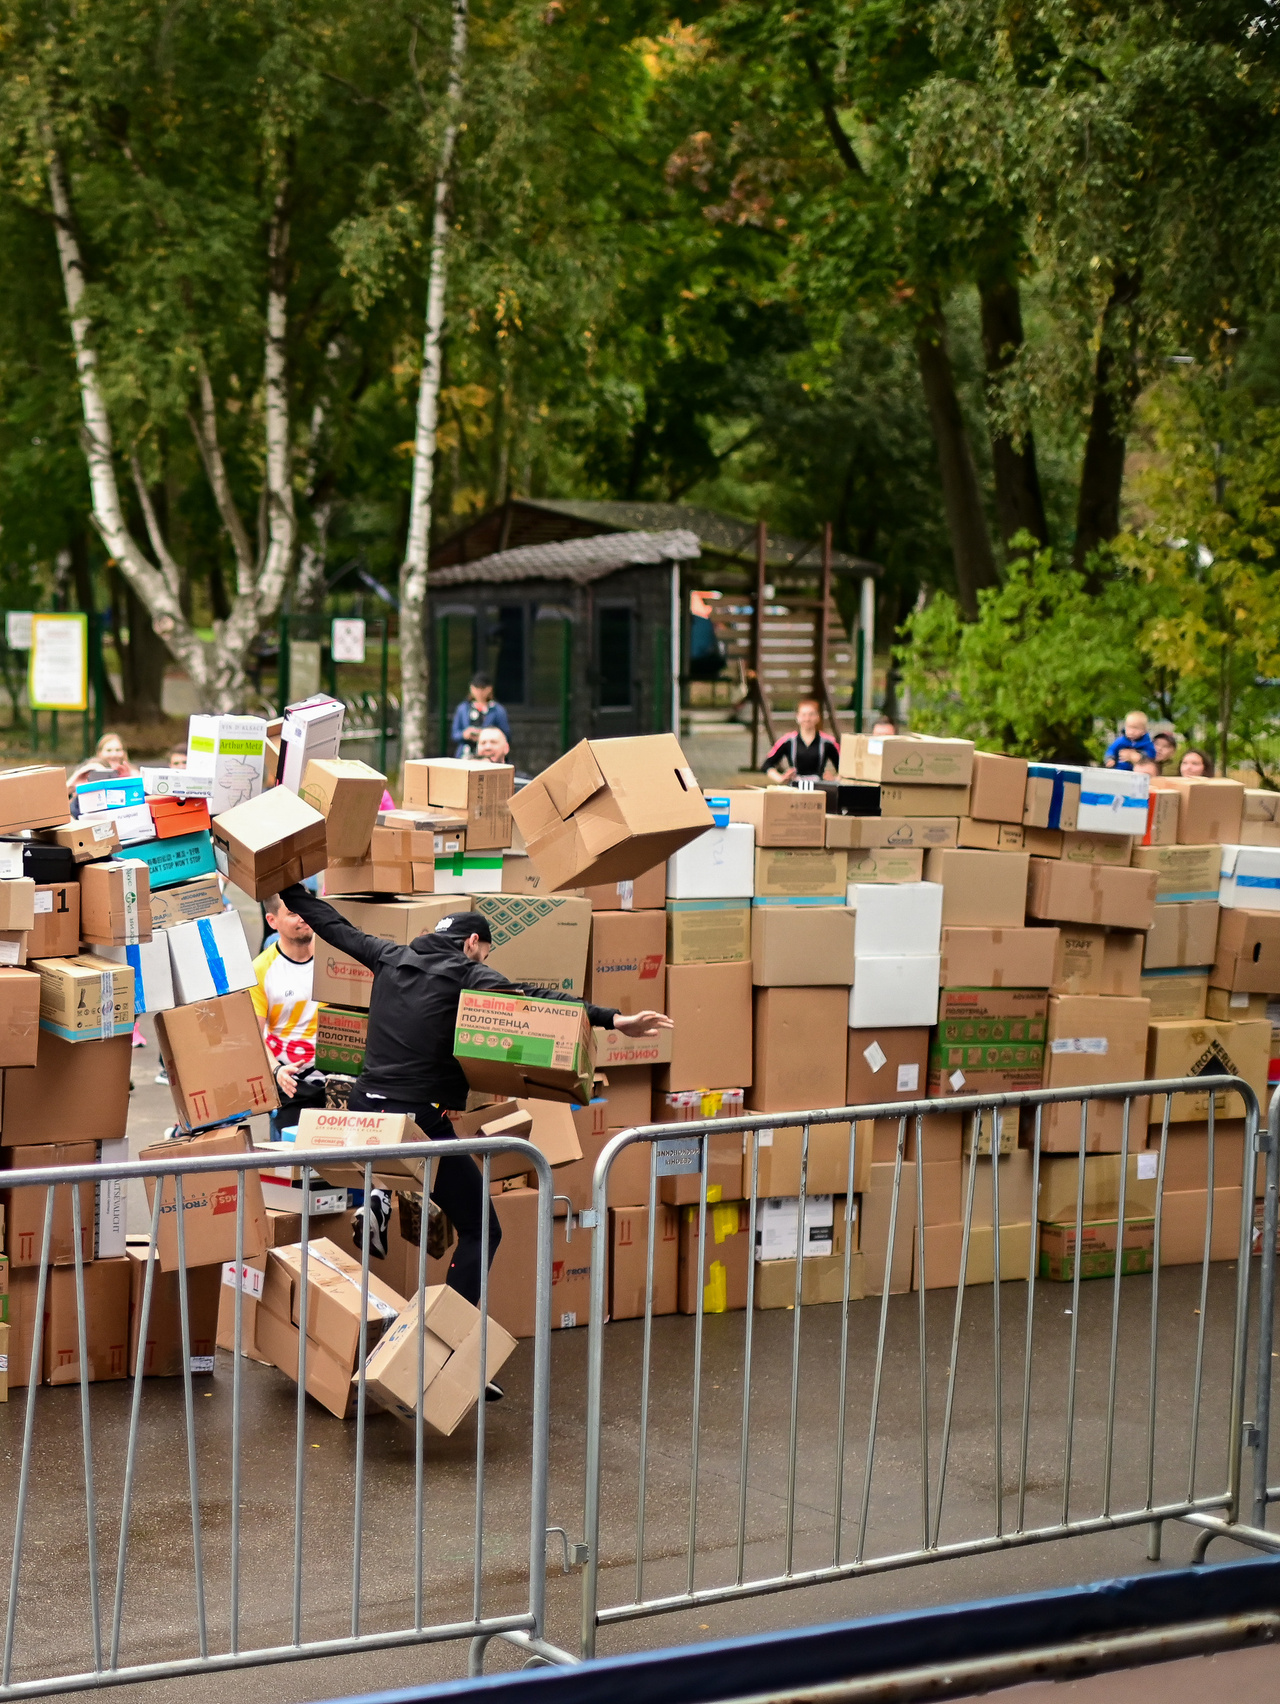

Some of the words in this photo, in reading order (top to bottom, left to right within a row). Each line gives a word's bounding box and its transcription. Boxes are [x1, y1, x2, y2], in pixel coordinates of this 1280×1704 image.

[220, 740, 244, 750] Arthur
[246, 740, 263, 750] Metz
[163, 862, 174, 870] STOP
[175, 858, 188, 867] WON'T
[190, 856, 201, 864] STOP
[57, 888, 70, 912] 1
[1065, 939, 1092, 948] STAFF
[463, 1006, 513, 1017] PROFESSIONAL
[474, 998, 514, 1012] Laima
[522, 1004, 579, 1018] ADVANCED
[328, 1017, 361, 1030] Laima
[461, 1014, 530, 1030] ПОЛОТЕНЦА
[606, 1049, 659, 1061] ОФИСМАГ
[1187, 1044, 1213, 1077] LEROY
[1211, 1040, 1239, 1076] MERLIN
[317, 1115, 385, 1128] ОФИСМАГ
[160, 1200, 208, 1214] FROSCH
